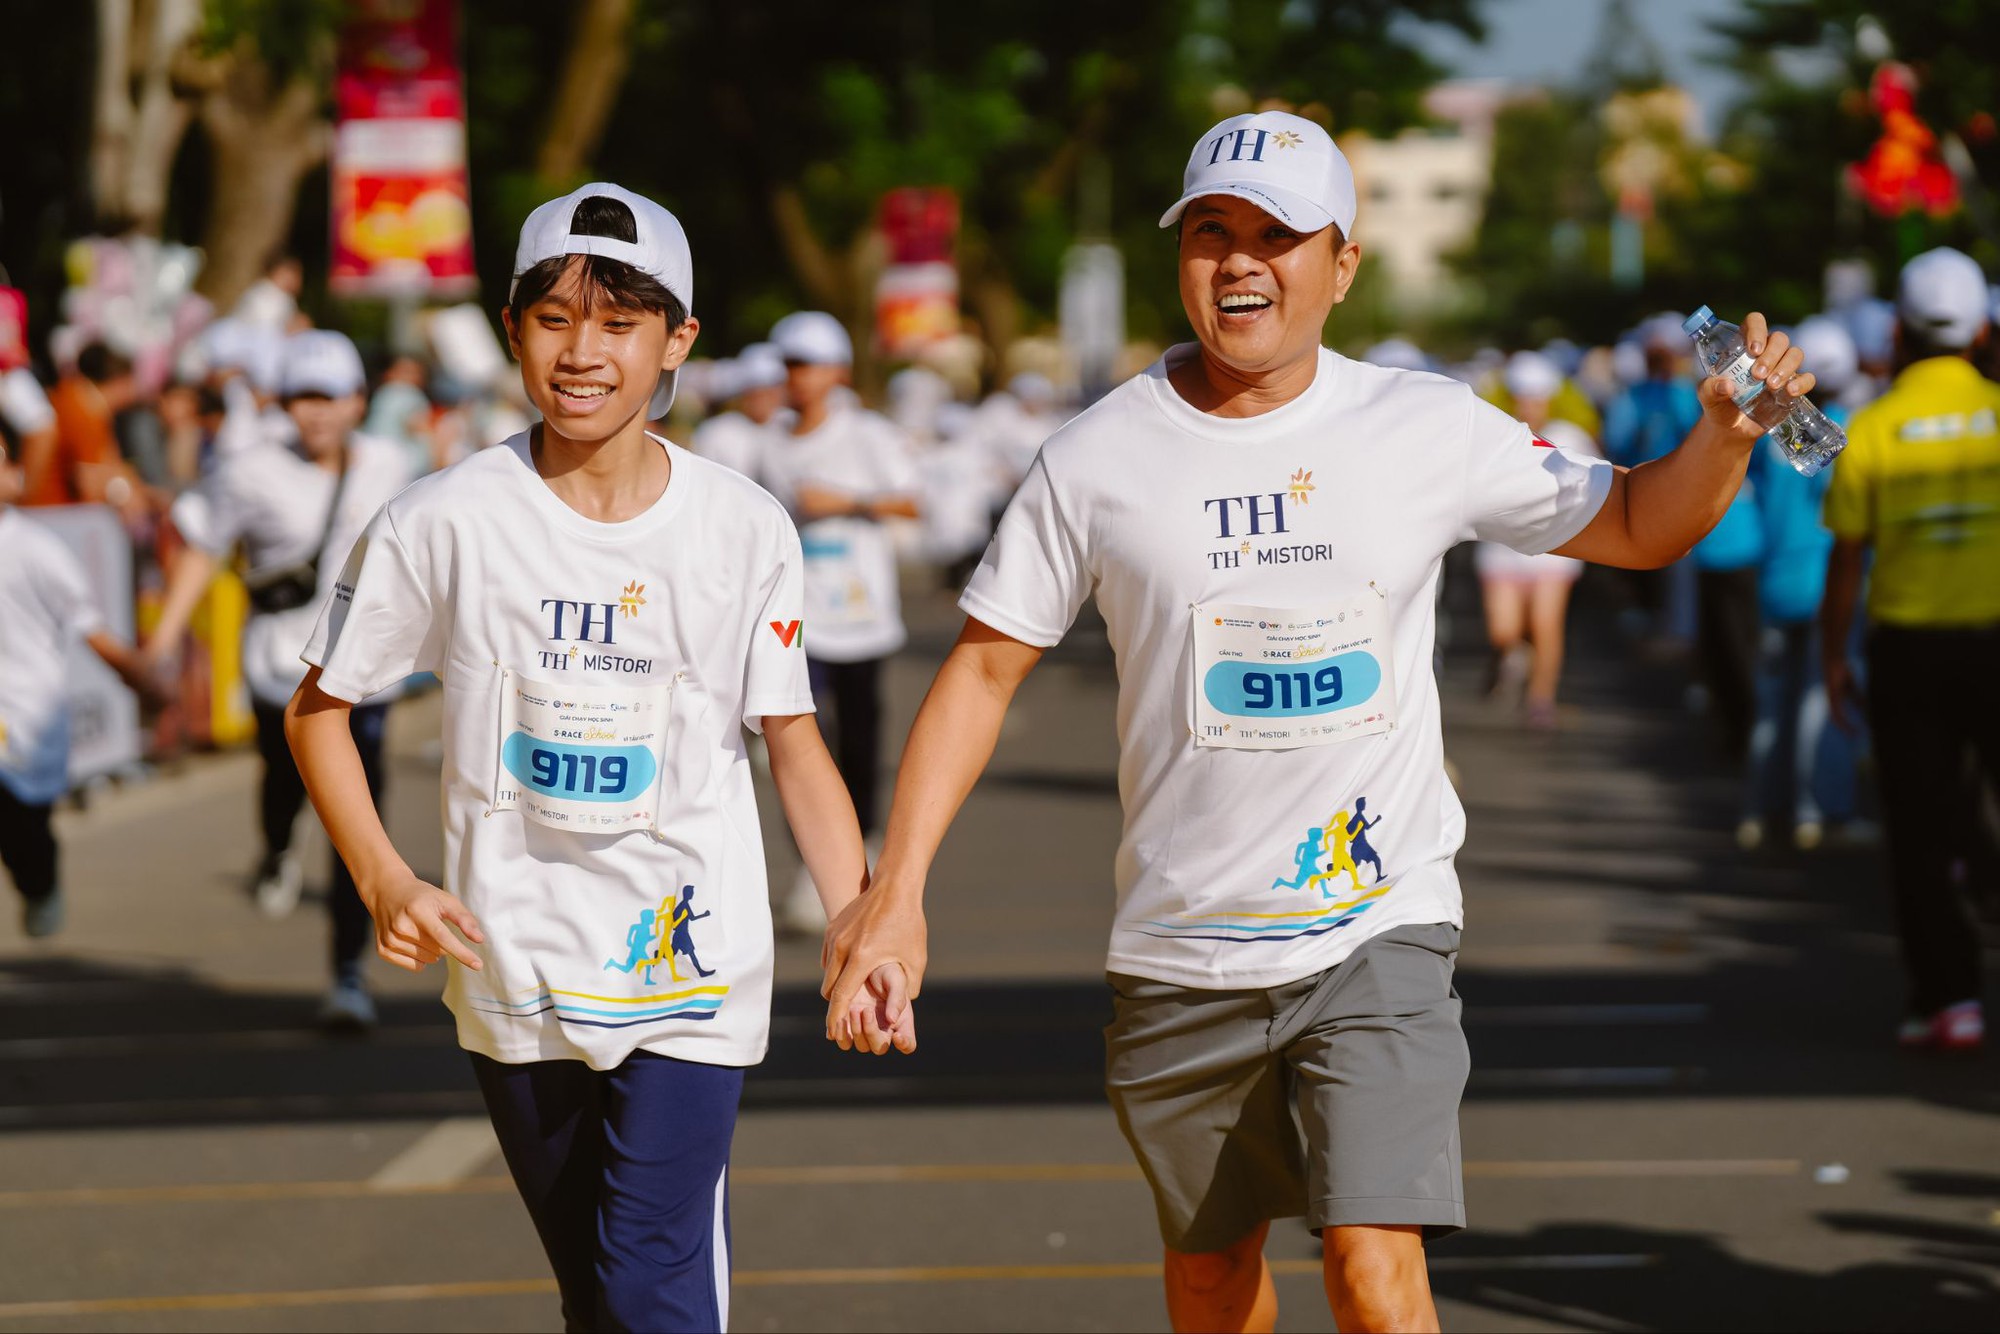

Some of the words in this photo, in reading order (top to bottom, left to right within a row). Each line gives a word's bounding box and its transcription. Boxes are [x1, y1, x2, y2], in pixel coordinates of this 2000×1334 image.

[1206, 129, 1271, 167] TH
[1204, 492, 1290, 538] TH
[1207, 550, 1241, 569] TH
[1257, 544, 1333, 565] MISTORI
[541, 599, 619, 645] TH
[538, 651, 569, 670] TH
[583, 655, 652, 674] MISTORI
[1242, 665, 1343, 709] 9119
[1204, 725, 1223, 737] TH
[1239, 730, 1252, 738] TH
[1258, 730, 1290, 739] MISTORI
[531, 749, 628, 794] 9119
[499, 790, 517, 801] TH
[540, 808, 569, 822] MISTORI
